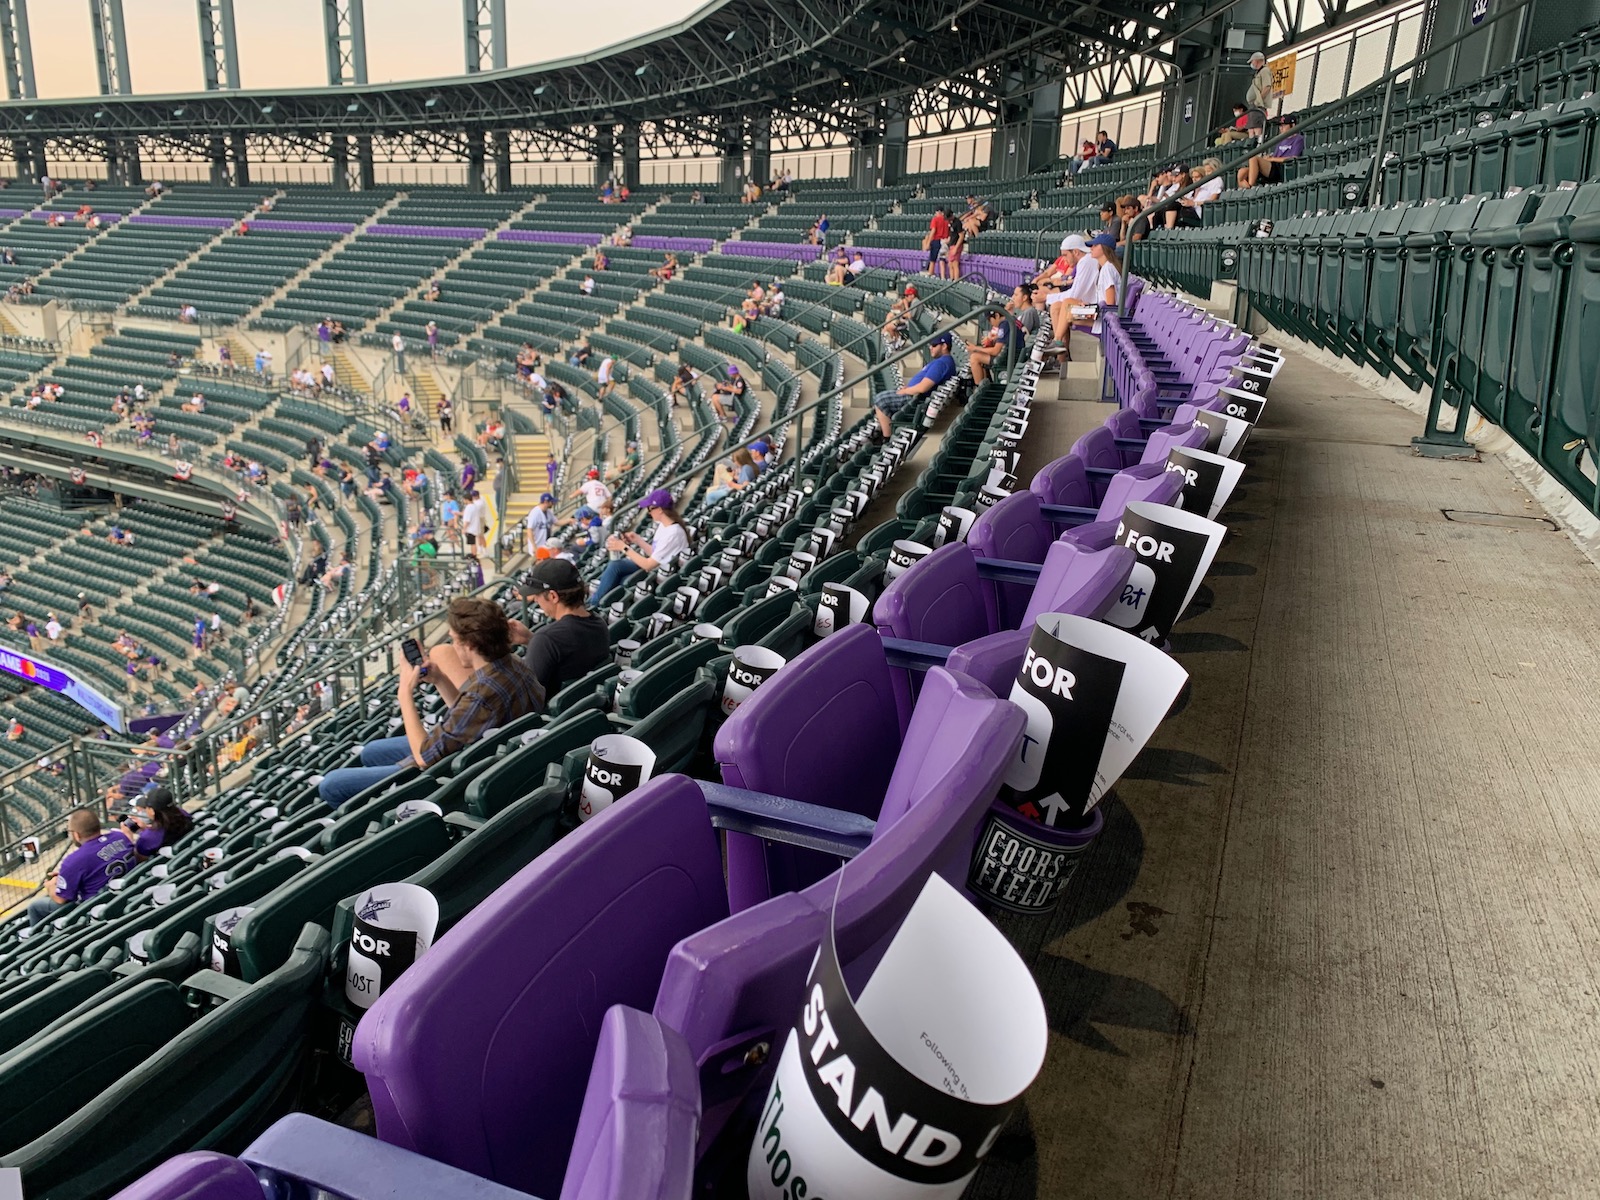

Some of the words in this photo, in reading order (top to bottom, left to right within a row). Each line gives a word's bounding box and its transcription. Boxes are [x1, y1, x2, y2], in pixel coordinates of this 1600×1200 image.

[1124, 529, 1175, 563] FOR
[735, 668, 762, 685] FOR
[1022, 647, 1077, 701] FOR
[590, 765, 622, 786] FOR
[988, 831, 1065, 878] COORS
[976, 857, 1053, 906] FIELD
[353, 927, 391, 957] FOR
[803, 982, 962, 1167] STAND
[920, 1031, 960, 1086] Following
[960, 1083, 971, 1099] th
